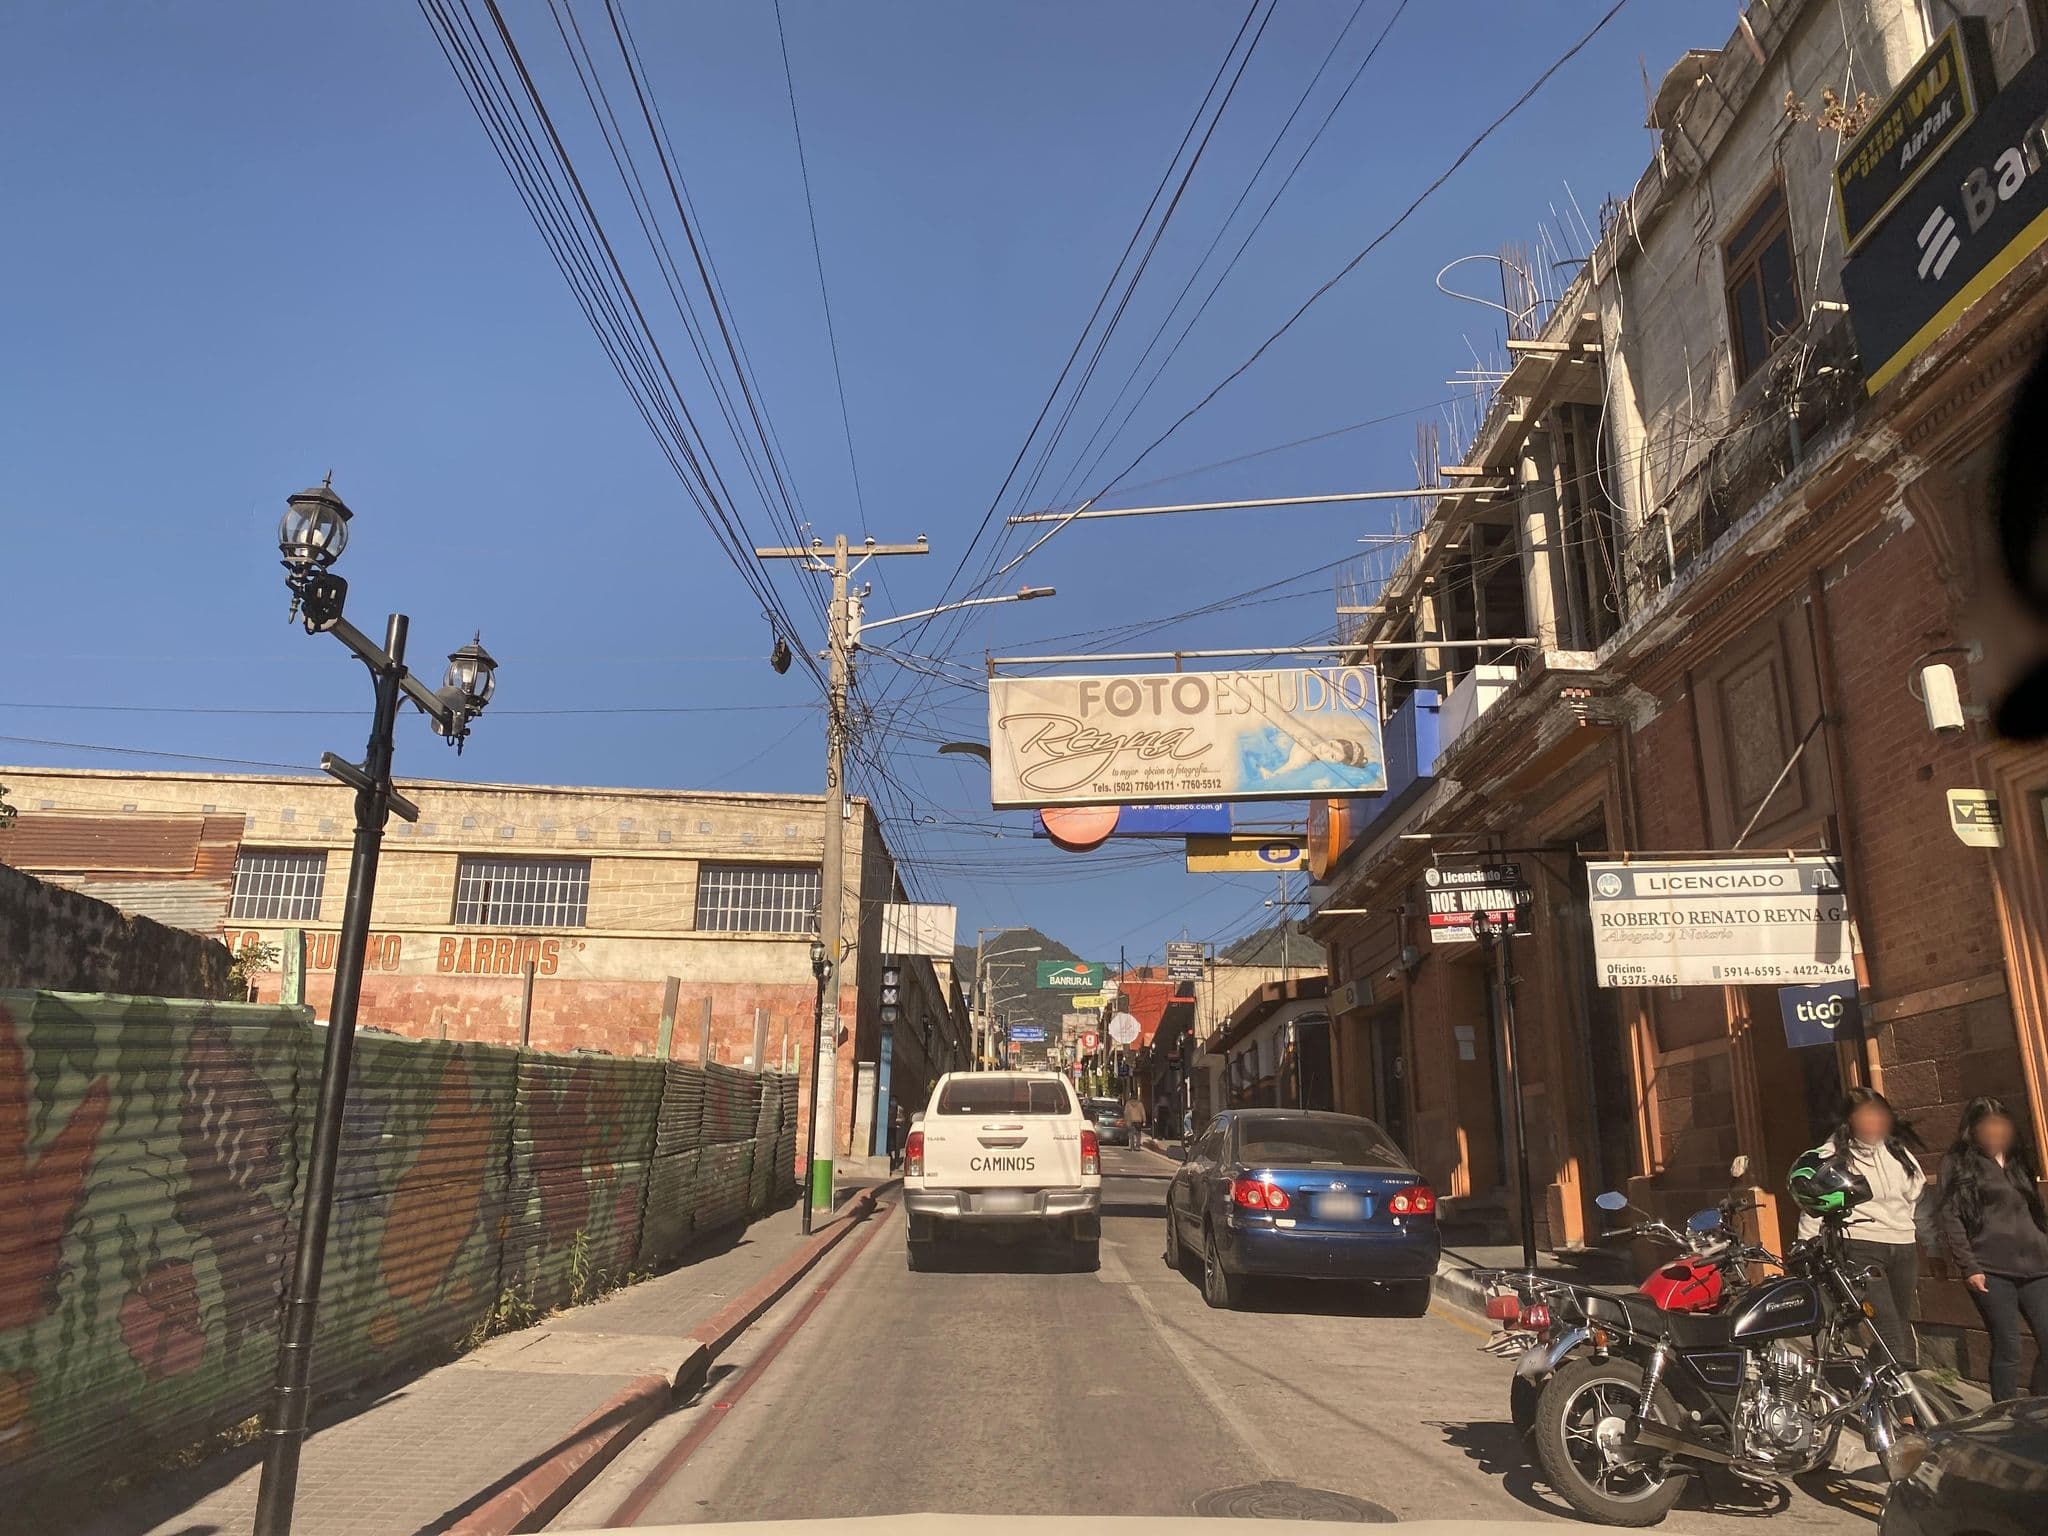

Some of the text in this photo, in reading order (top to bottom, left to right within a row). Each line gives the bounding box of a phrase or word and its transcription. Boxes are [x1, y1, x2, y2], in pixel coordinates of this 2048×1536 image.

[1900, 99, 1953, 170] AirPak
[999, 712, 1214, 793] Reyna
[1092, 778, 1222, 794] Tels. (502) 7760-1171 7760-5512
[1442, 870, 1500, 884] Licenciado
[1649, 874, 1784, 890] LICENCIADO
[1430, 891, 1458, 913] NOE
[1601, 911, 1684, 927] ROBERTO
[1688, 909, 1760, 926] RENATO
[1764, 908, 1824, 924] REYNA
[1602, 928, 1734, 944] Abogado y Notario
[305, 933, 402, 971] RUNO
[1606, 964, 1646, 974] Oficina:
[1724, 966, 1781, 977] 5914-6595
[1793, 965, 1850, 976] 4422-4246
[1049, 976, 1093, 986] BANRURAL
[1622, 975, 1678, 985] 5375-9465
[1797, 996, 1844, 1028] tigo
[970, 1157, 1036, 1171] CAMINOS
